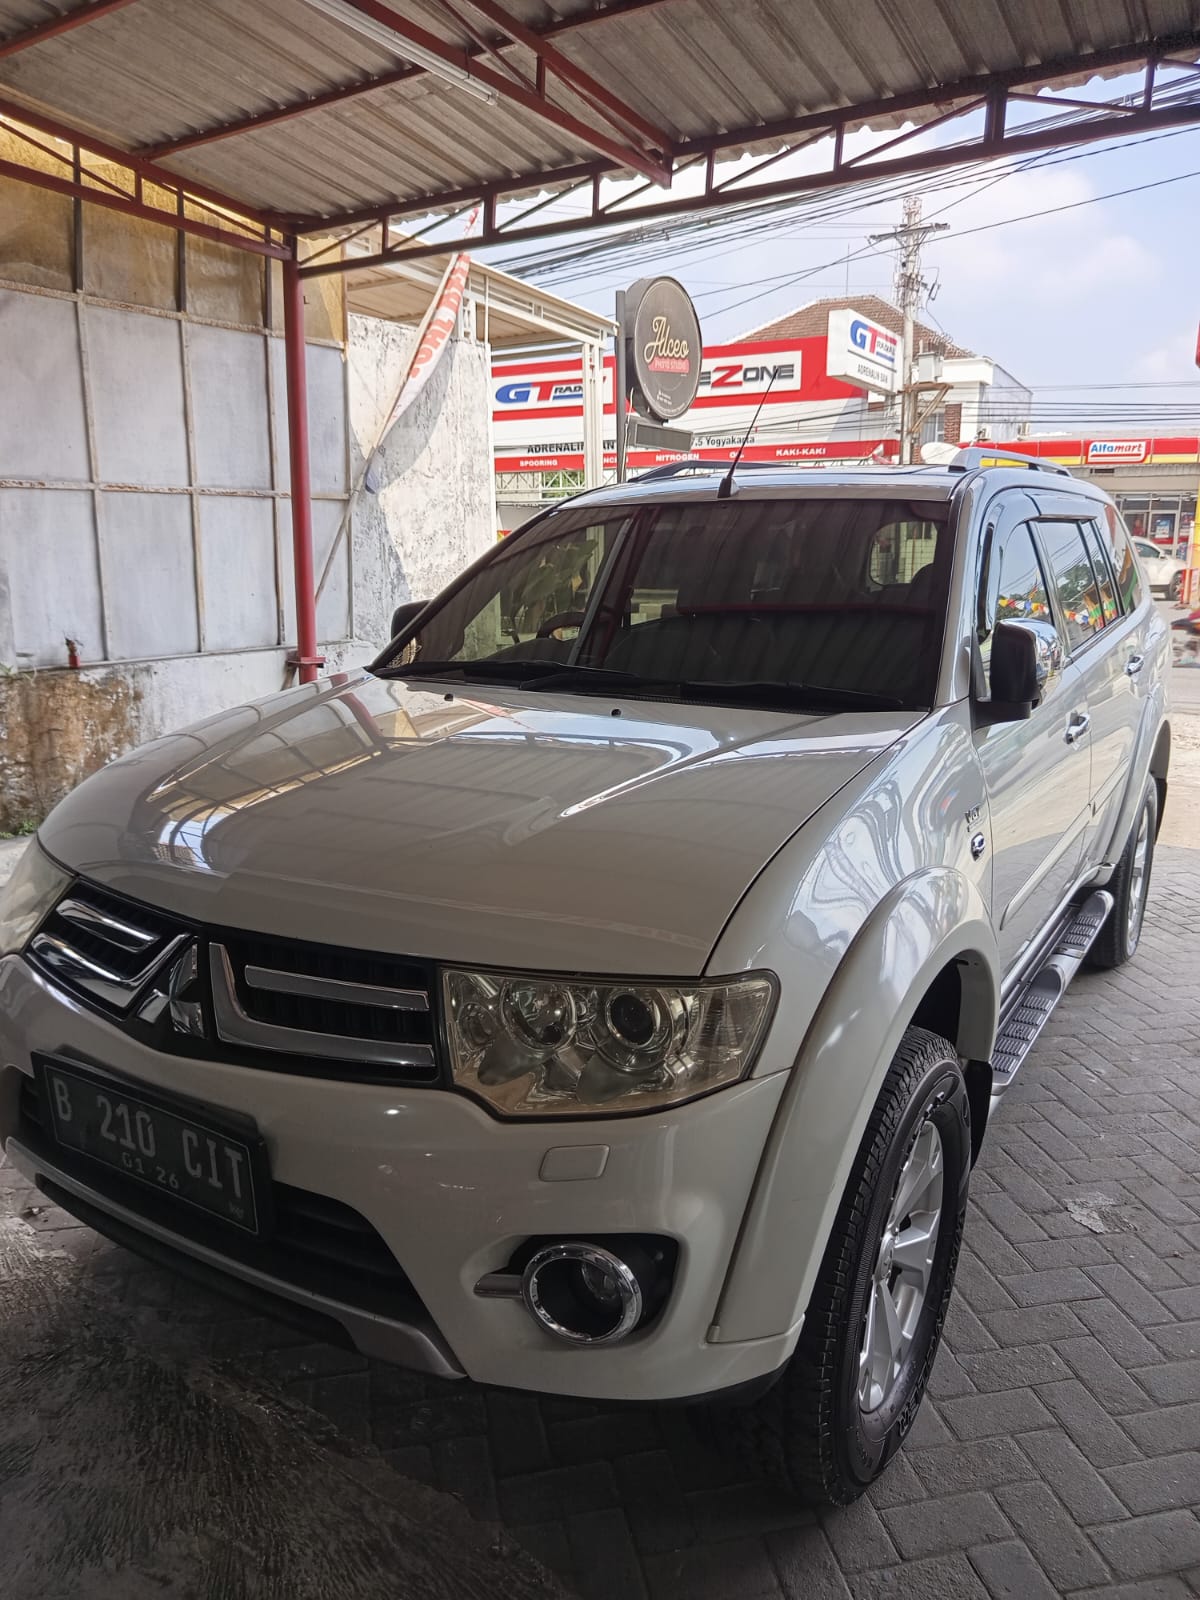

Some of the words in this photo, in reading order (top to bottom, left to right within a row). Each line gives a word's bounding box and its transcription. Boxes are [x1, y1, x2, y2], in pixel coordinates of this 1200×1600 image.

[644, 316, 689, 363] Alceo
[699, 364, 795, 389] EZONE
[495, 379, 556, 404] GT
[553, 385, 583, 395] RAD
[519, 459, 558, 467] SPOORING
[655, 453, 700, 462] NITROGEN
[775, 448, 826, 457] KAKI-KAKI
[1091, 443, 1143, 453] Alfamart
[52, 1077, 72, 1122] B
[96, 1095, 157, 1159] 210
[181, 1127, 243, 1199] CIT
